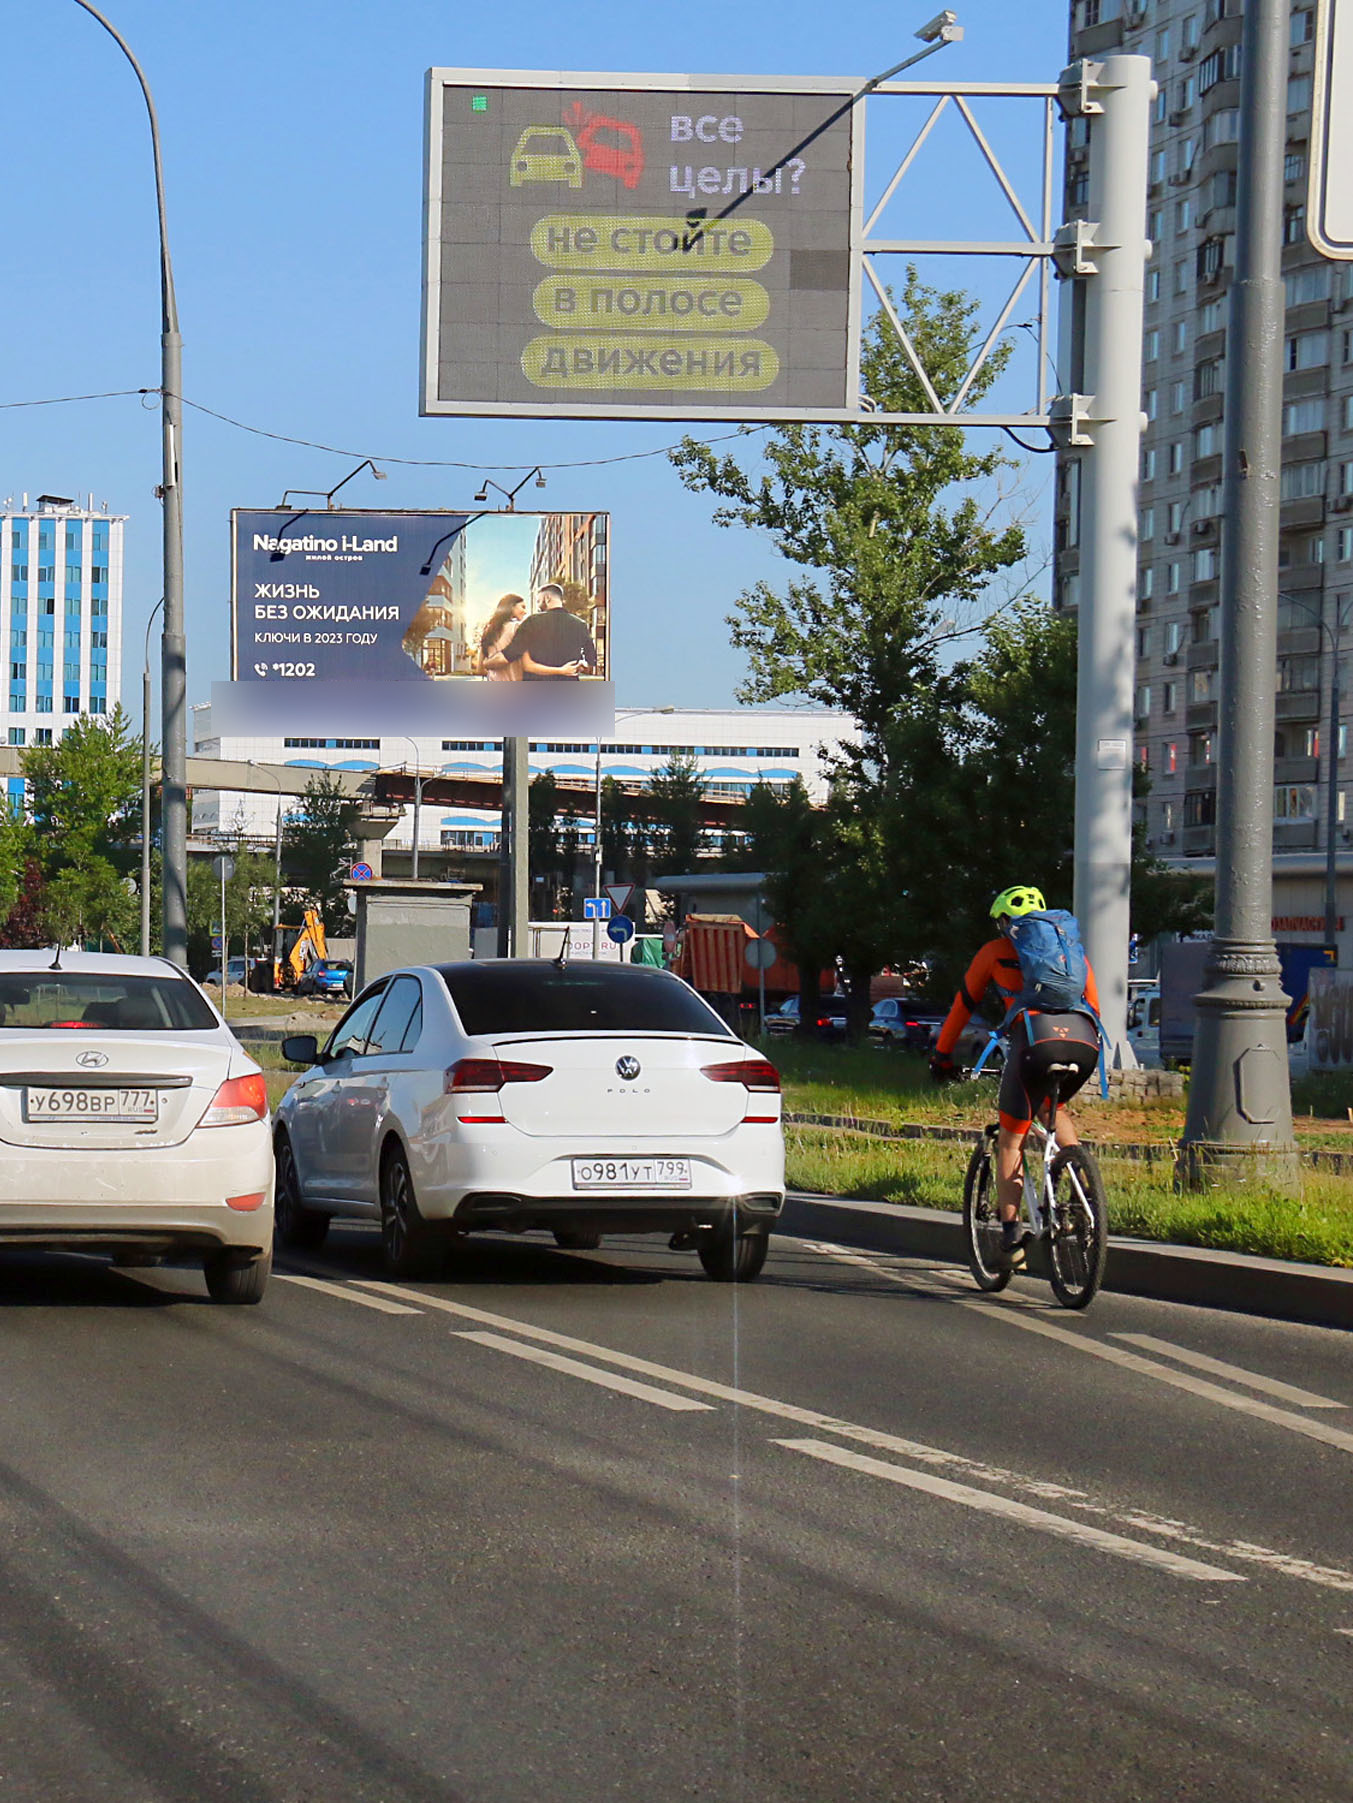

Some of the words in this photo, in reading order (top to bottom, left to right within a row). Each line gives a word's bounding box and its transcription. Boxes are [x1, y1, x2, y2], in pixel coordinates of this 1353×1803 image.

[669, 115, 745, 144] все
[669, 158, 807, 199] целы?
[548, 227, 598, 254] не
[611, 222, 752, 256] стойте
[555, 287, 576, 313] в
[590, 287, 744, 317] полосе
[540, 347, 762, 377] движения
[253, 534, 338, 555] Nagatino
[342, 535, 399, 552] i-Land
[254, 583, 320, 599] ЖИЗНЬ
[254, 604, 288, 620] БЕЗ
[292, 605, 400, 622] ОЖИДАНИЯ
[254, 632, 301, 643] КЛЮЧИ
[303, 633, 312, 643] В
[314, 633, 343, 644] 2023
[346, 633, 378, 645] ГОДУ
[120, 1091, 150, 1106] 777
[656, 1161, 685, 1175] 799
